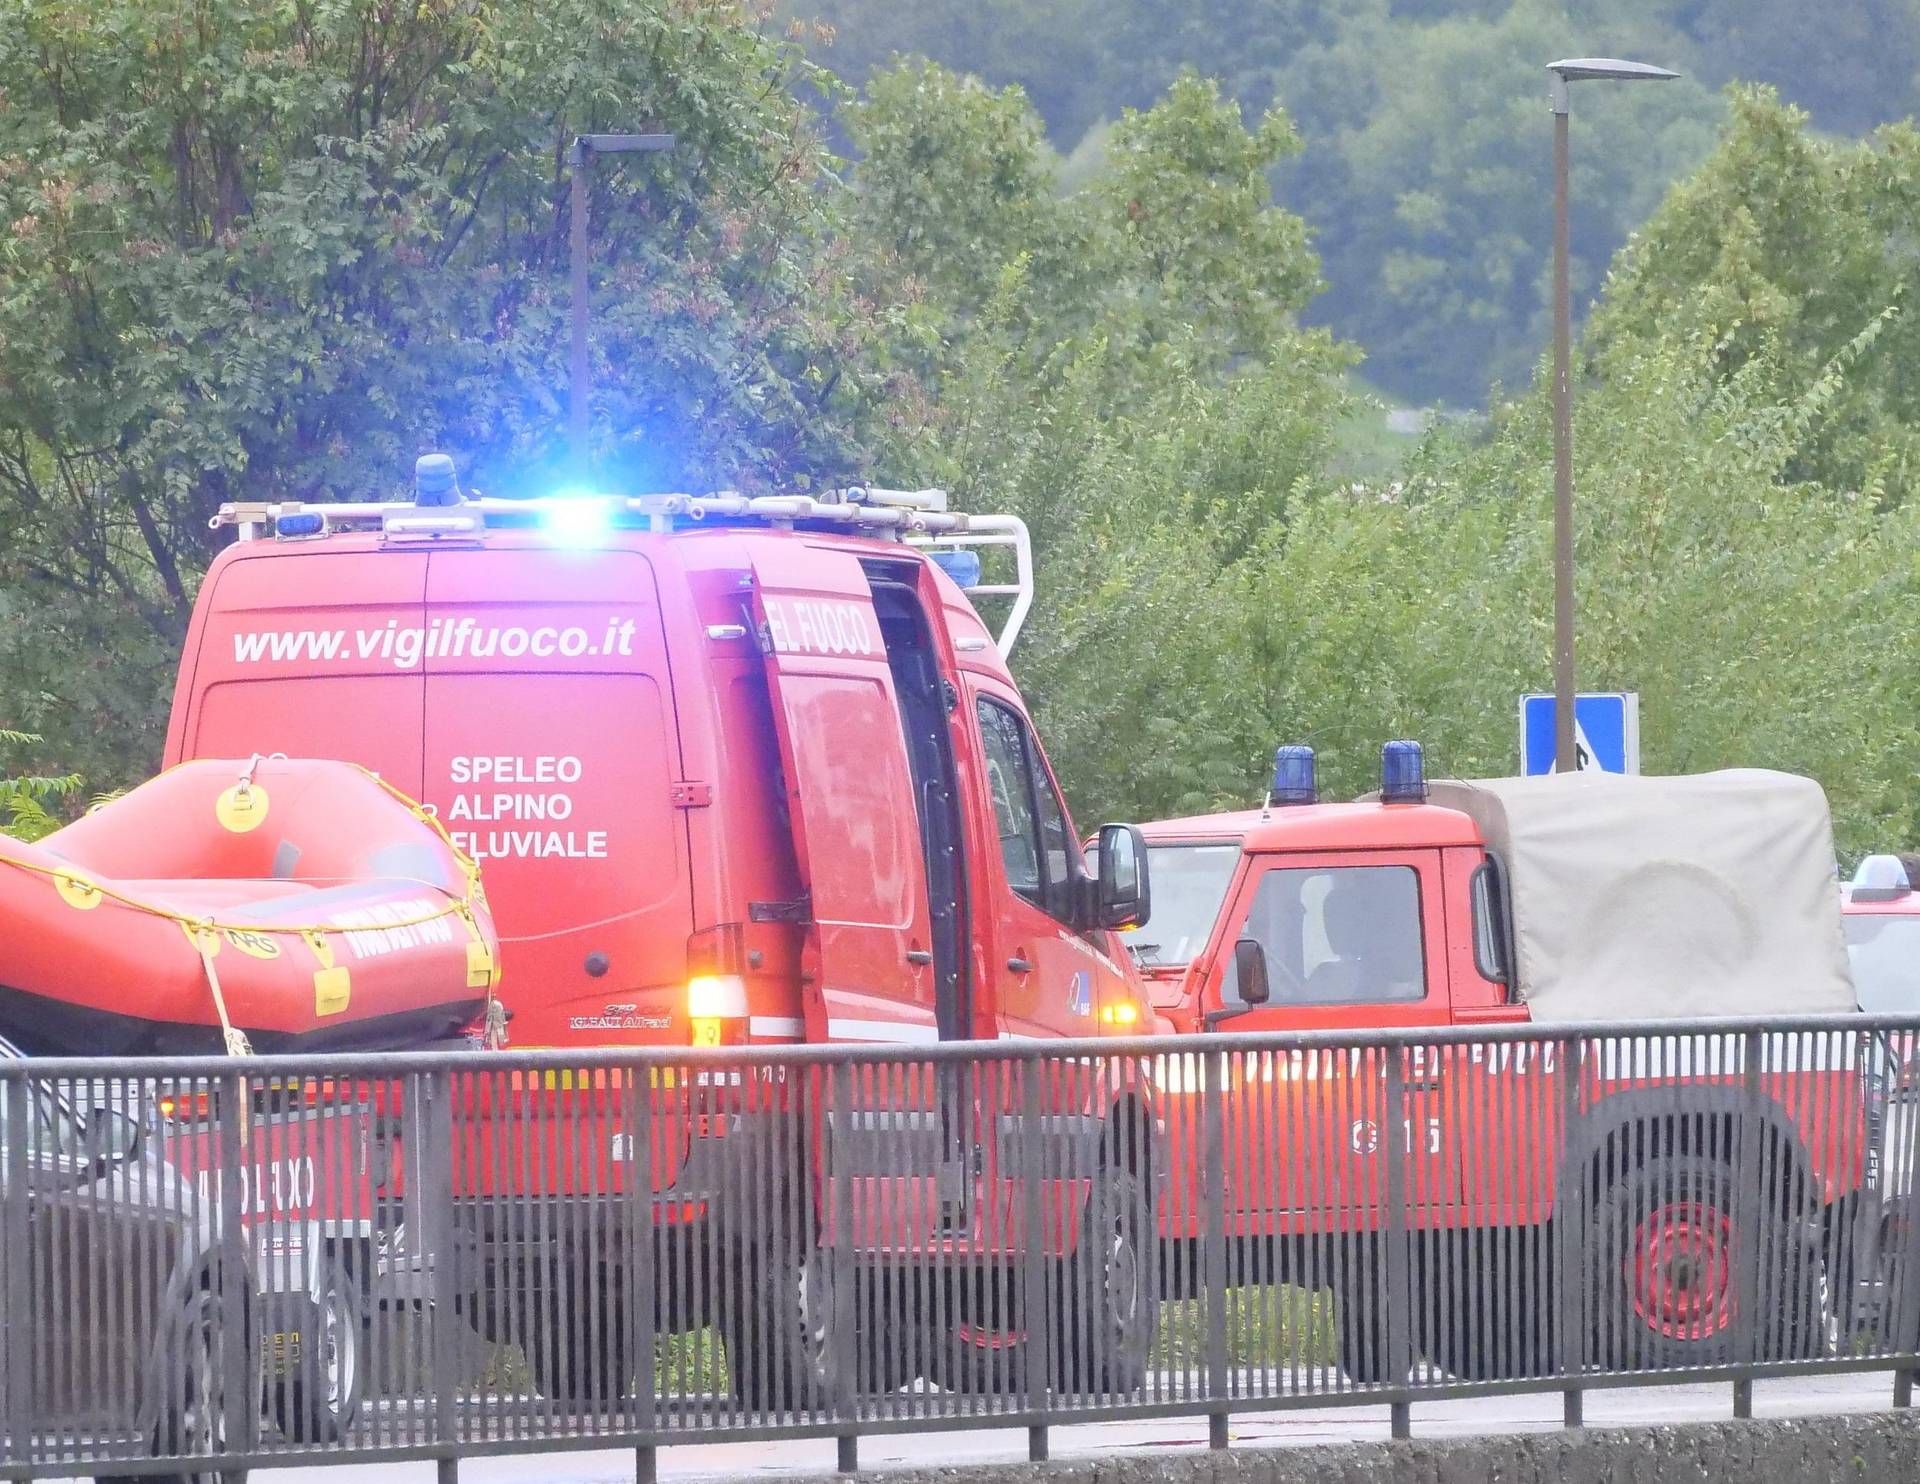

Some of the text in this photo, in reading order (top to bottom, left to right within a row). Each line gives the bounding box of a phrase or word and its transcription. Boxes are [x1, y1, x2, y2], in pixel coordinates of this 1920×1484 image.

[793, 601, 871, 655] FUOCO
[234, 617, 636, 667] www.vigilfuoco.it
[450, 757, 582, 782] SPELEO
[449, 794, 572, 820] ALPINO
[450, 832, 608, 858] FLUVIALE
